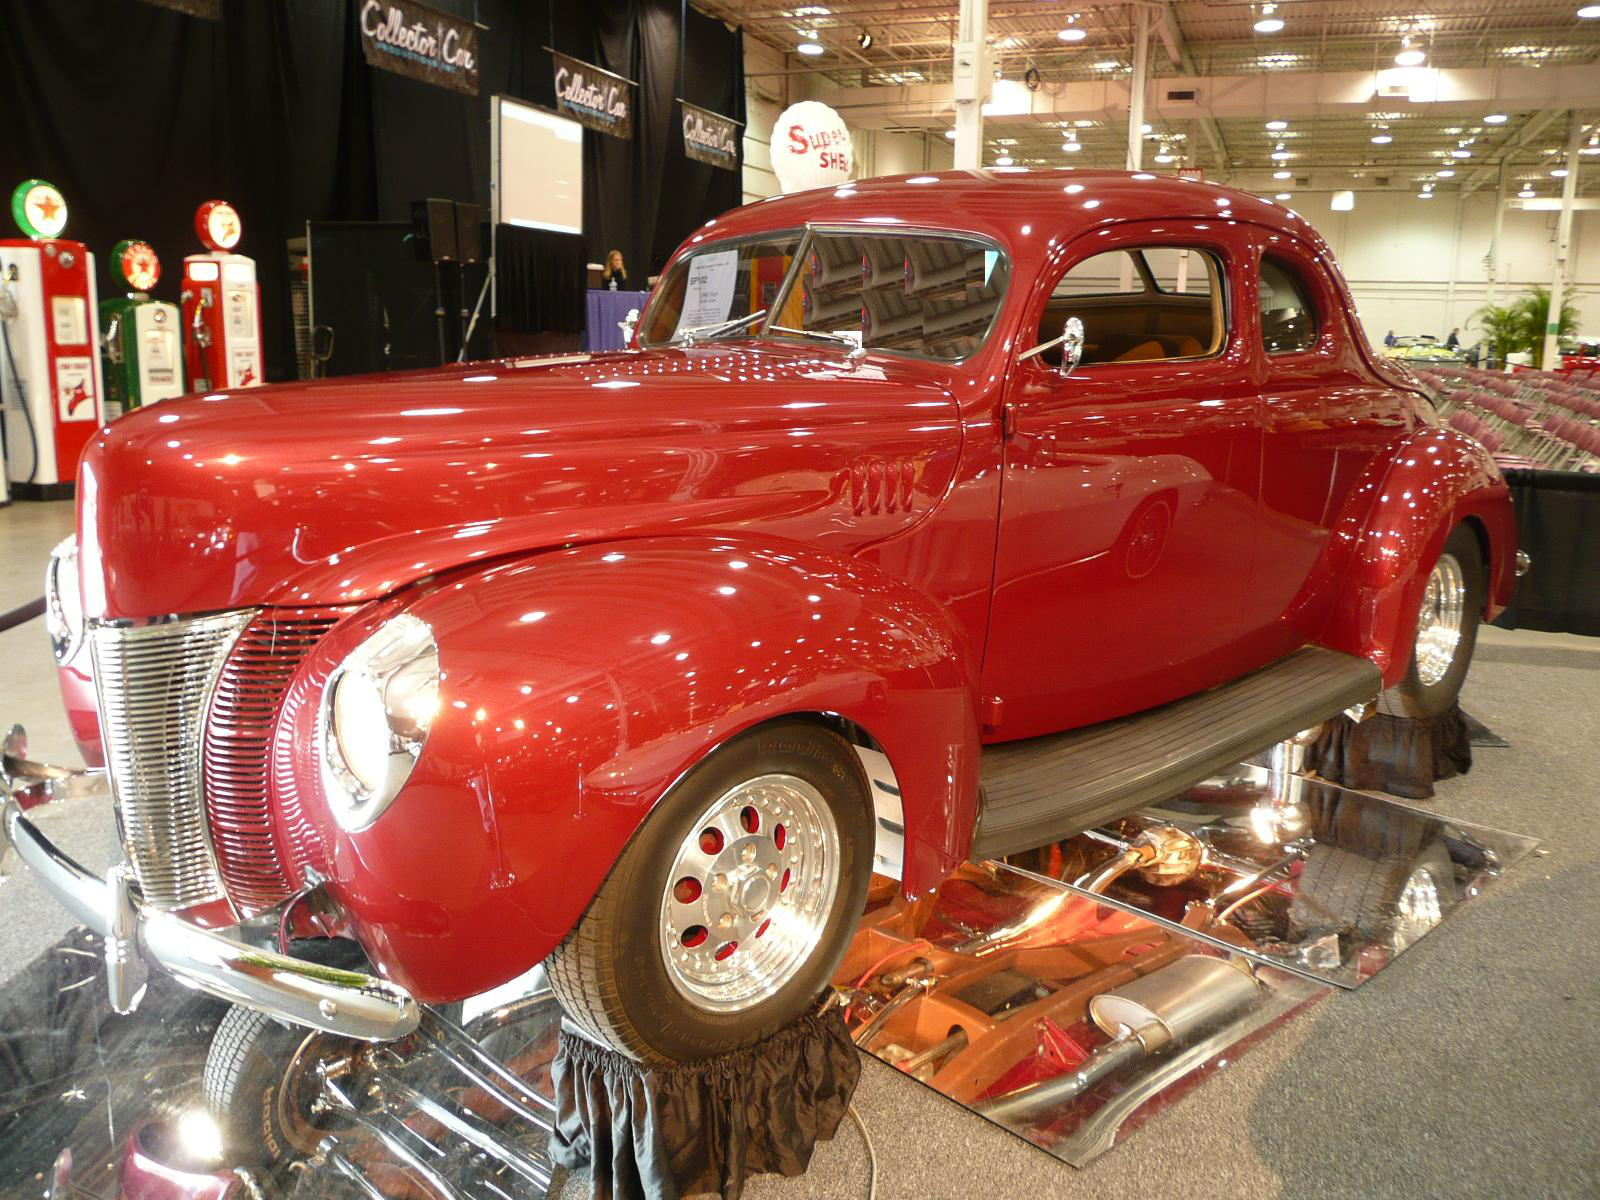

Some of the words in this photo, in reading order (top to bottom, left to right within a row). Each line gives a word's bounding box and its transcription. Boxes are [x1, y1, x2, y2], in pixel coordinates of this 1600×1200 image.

[361, 0, 437, 57] Collector
[443, 28, 474, 69] Car
[555, 67, 604, 110] Collector
[608, 87, 626, 118] Car
[820, 152, 848, 172] SHEL
